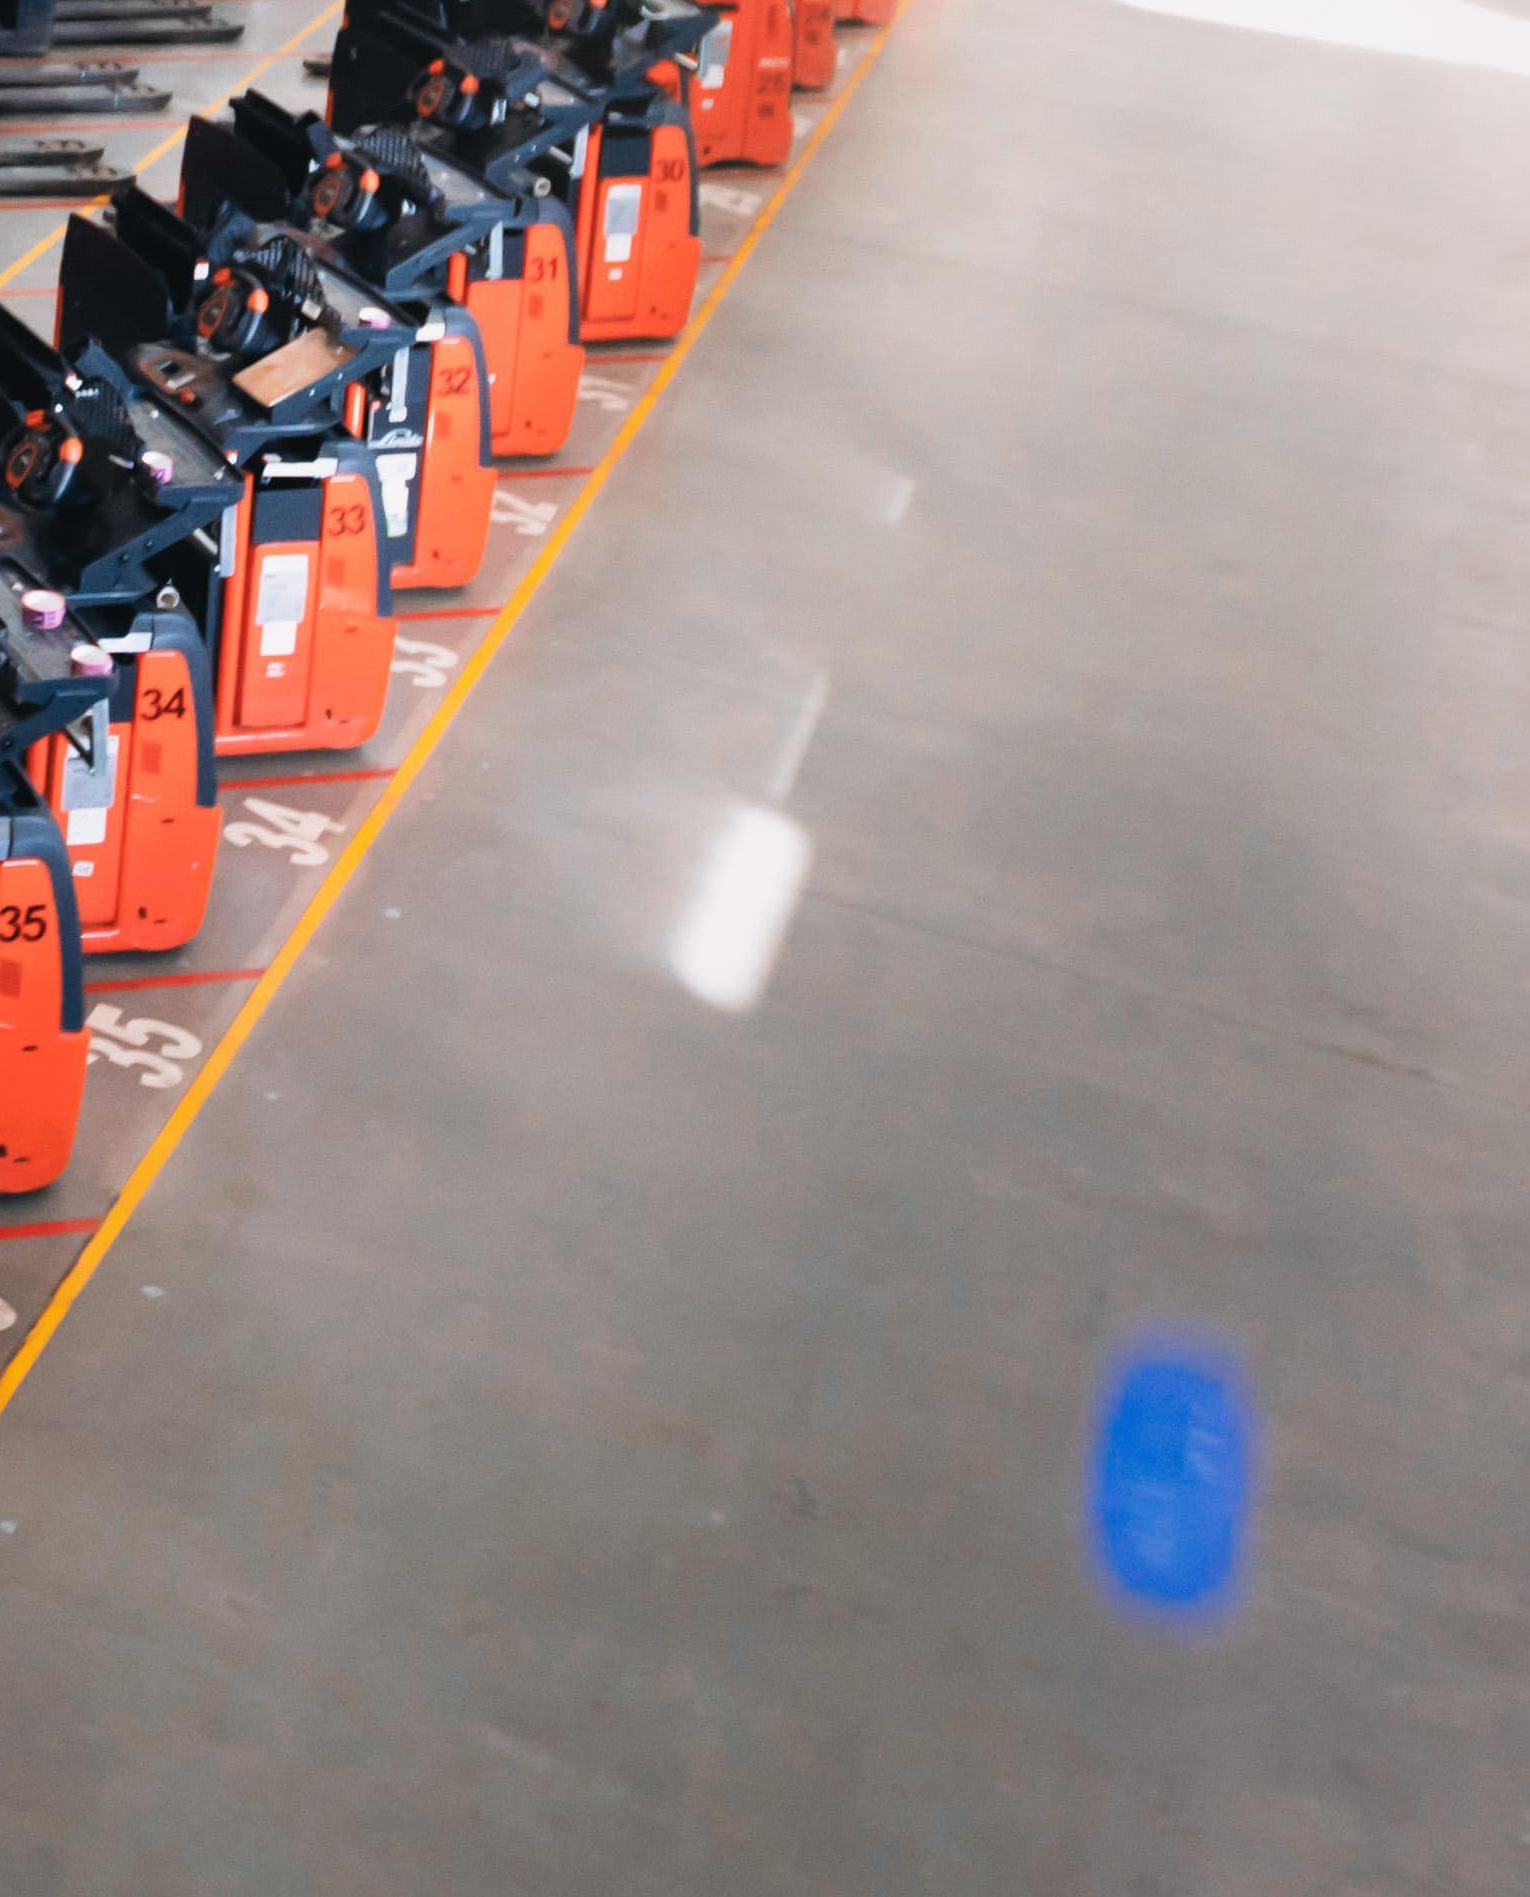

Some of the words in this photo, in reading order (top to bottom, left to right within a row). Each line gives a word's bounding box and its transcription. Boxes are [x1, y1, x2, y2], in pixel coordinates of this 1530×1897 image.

[530, 257, 559, 283] 31
[438, 368, 471, 396] 32
[328, 505, 366, 536] 33
[141, 687, 185, 721] 34
[222, 797, 348, 866] 34
